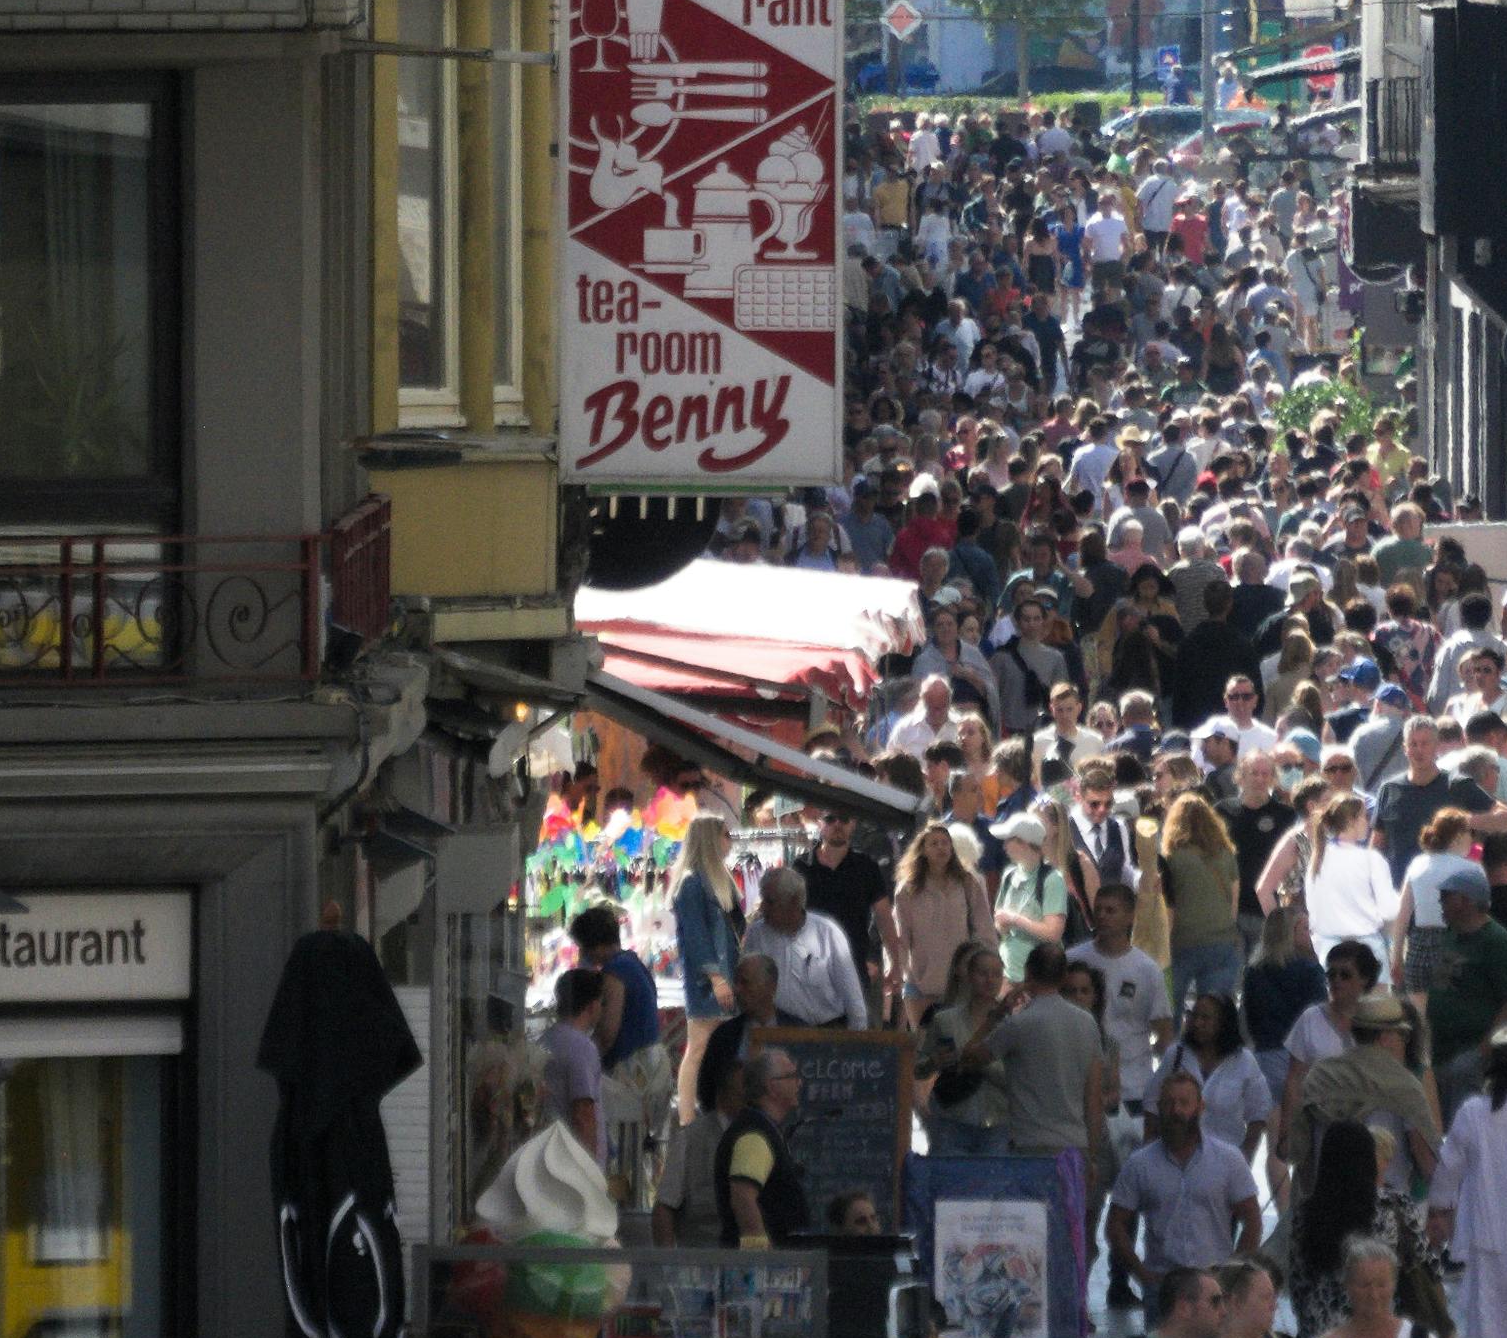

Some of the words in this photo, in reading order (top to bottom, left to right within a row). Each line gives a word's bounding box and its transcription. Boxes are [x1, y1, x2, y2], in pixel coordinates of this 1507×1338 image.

[576, 272, 663, 323] tea-
[615, 328, 722, 377] room
[575, 375, 792, 474] Benny
